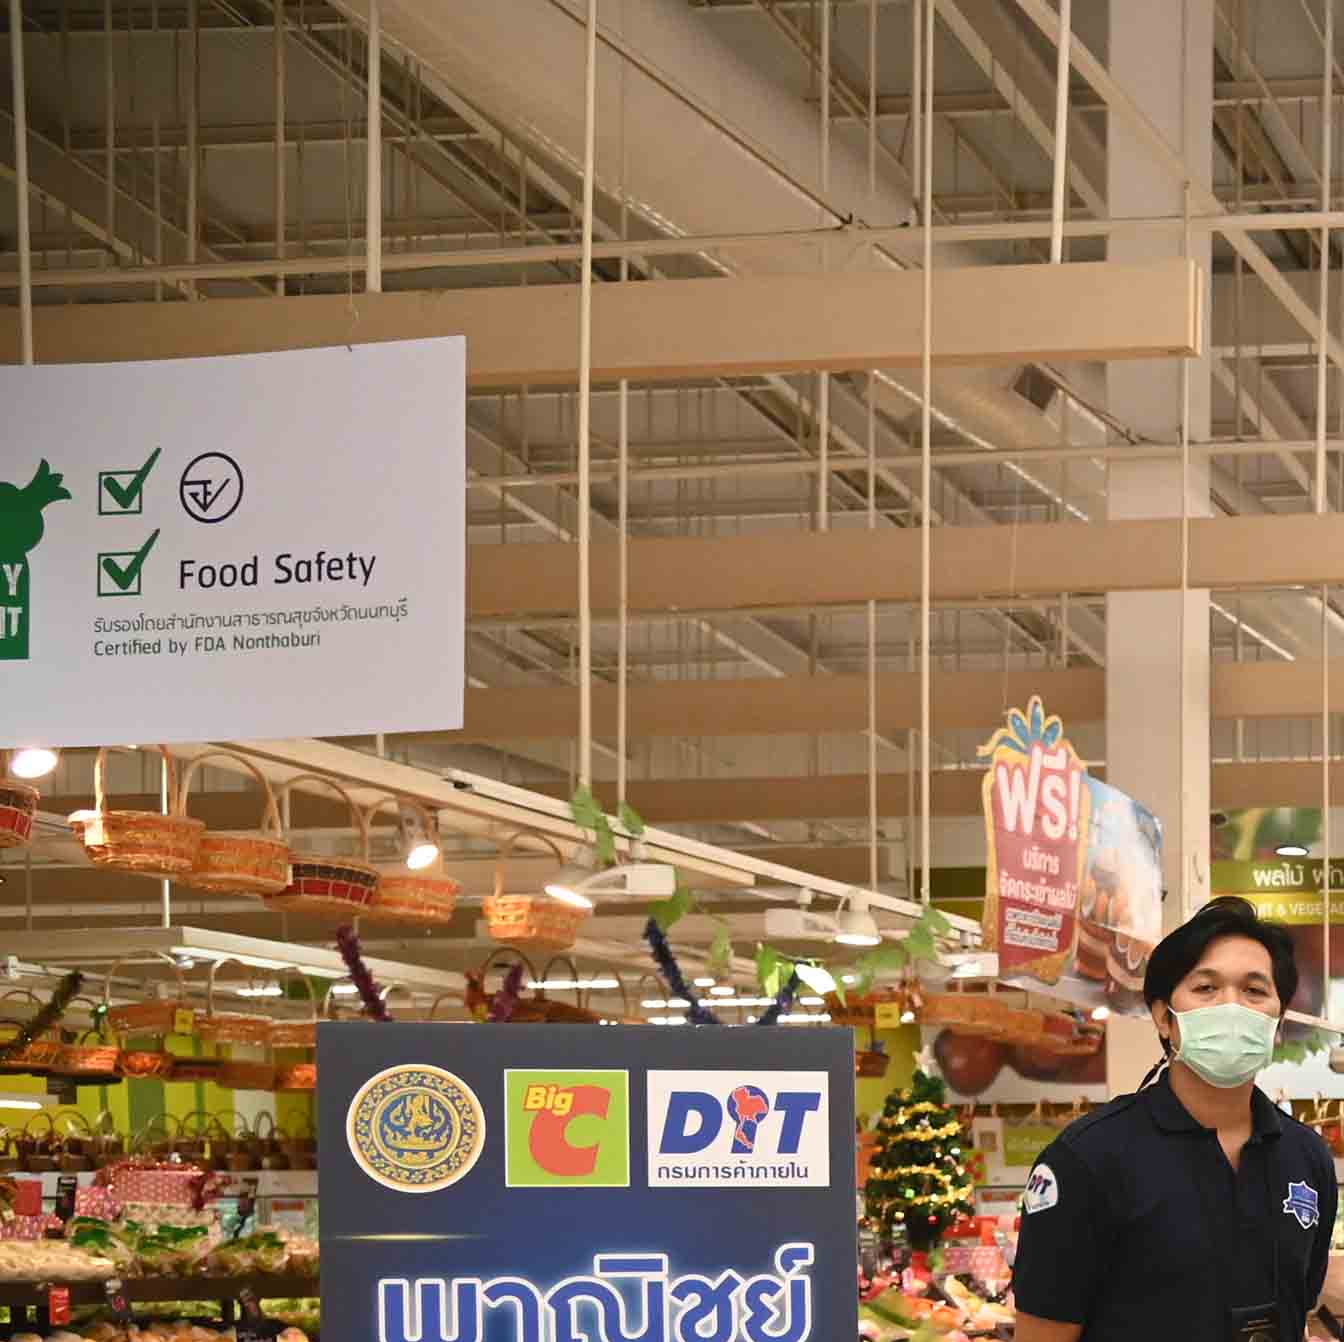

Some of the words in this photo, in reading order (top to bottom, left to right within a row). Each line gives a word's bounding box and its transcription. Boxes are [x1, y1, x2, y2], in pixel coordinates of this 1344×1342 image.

[180, 556, 259, 589] Food
[273, 553, 377, 586] Safety
[93, 638, 162, 656] Certified
[167, 638, 188, 656] by
[194, 636, 226, 652] FDA
[232, 632, 321, 650] Nonthaburi
[1252, 862, 1305, 887] ผลไม้
[524, 1083, 573, 1114] Big
[529, 1085, 611, 1177] C
[658, 1160, 809, 1180] กรมการค้าภายใน
